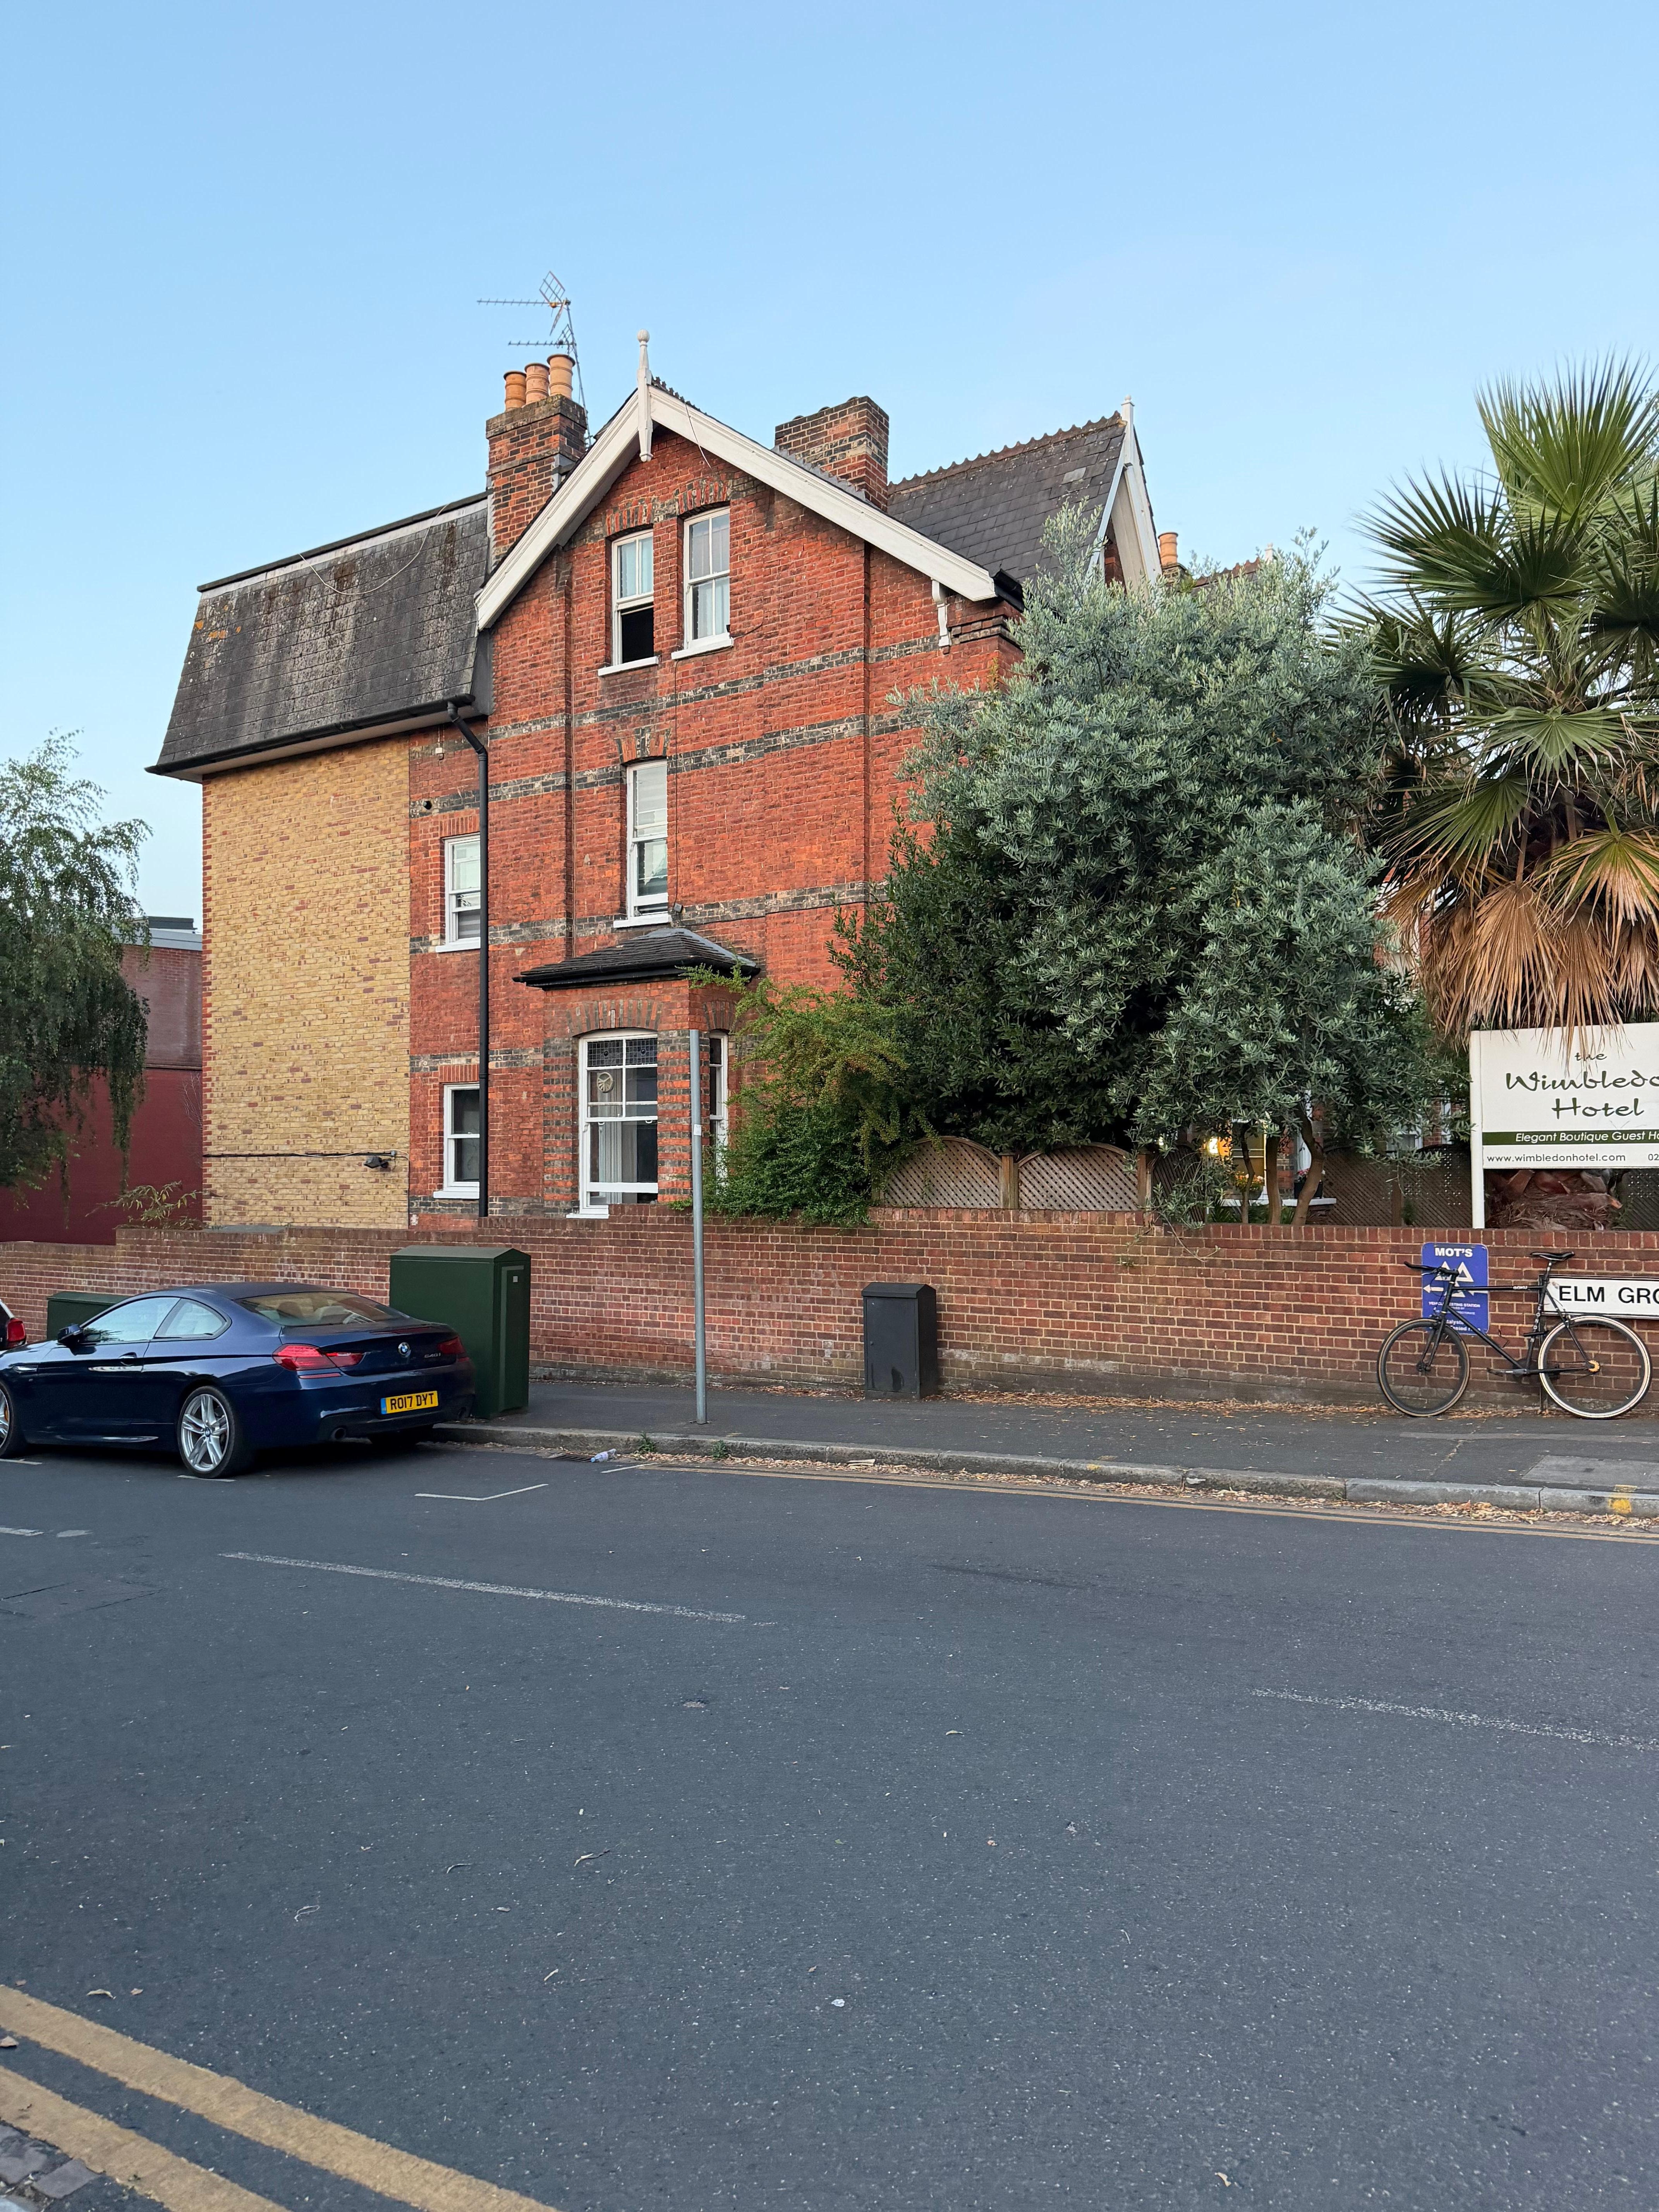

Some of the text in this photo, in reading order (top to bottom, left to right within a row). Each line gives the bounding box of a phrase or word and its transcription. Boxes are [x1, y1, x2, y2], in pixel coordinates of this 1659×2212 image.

[1551, 1097, 1644, 1119] Hotel
[1515, 1133, 1557, 1144] Elegant
[1559, 1132, 1608, 1142] Boutique
[1611, 1131, 1645, 1141] Guest
[1487, 1153, 1626, 1162] www.wimbledonhotel.com
[1435, 1248, 1473, 1257] MOT'S
[1559, 1286, 1605, 1302] ELM
[1530, 1305, 1541, 1342] LONDN
[390, 1393, 434, 1410] RO17 DYT
